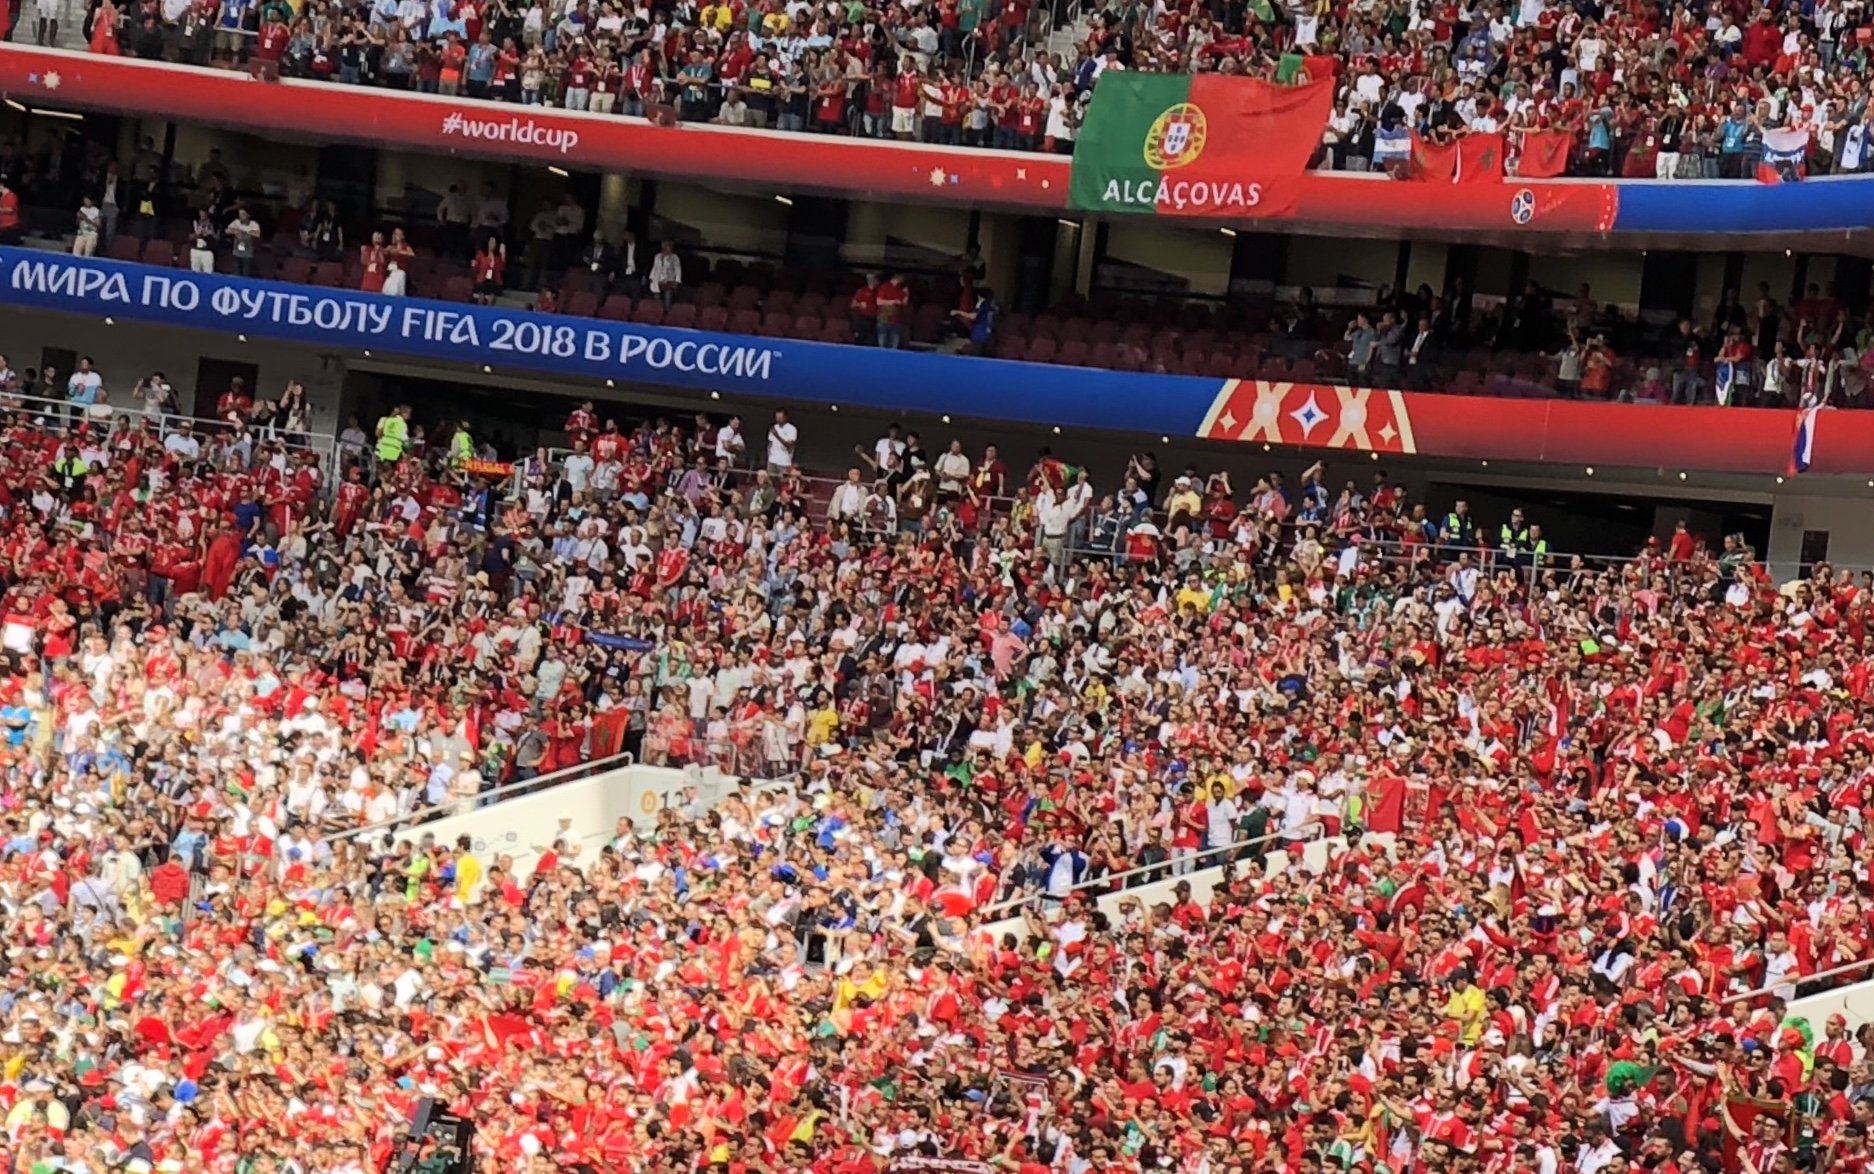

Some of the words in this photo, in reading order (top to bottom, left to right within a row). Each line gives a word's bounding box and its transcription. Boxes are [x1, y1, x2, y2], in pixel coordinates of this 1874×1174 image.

[442, 112, 579, 154] #worldcup
[1102, 175, 1262, 210] ALCÁÇOVAS
[11, 260, 131, 304] МИРА
[141, 275, 200, 311] ПО
[211, 285, 393, 334] ФУТБОЛУ
[401, 308, 480, 346] FIFA
[488, 318, 577, 358] 2018
[584, 330, 611, 362] В
